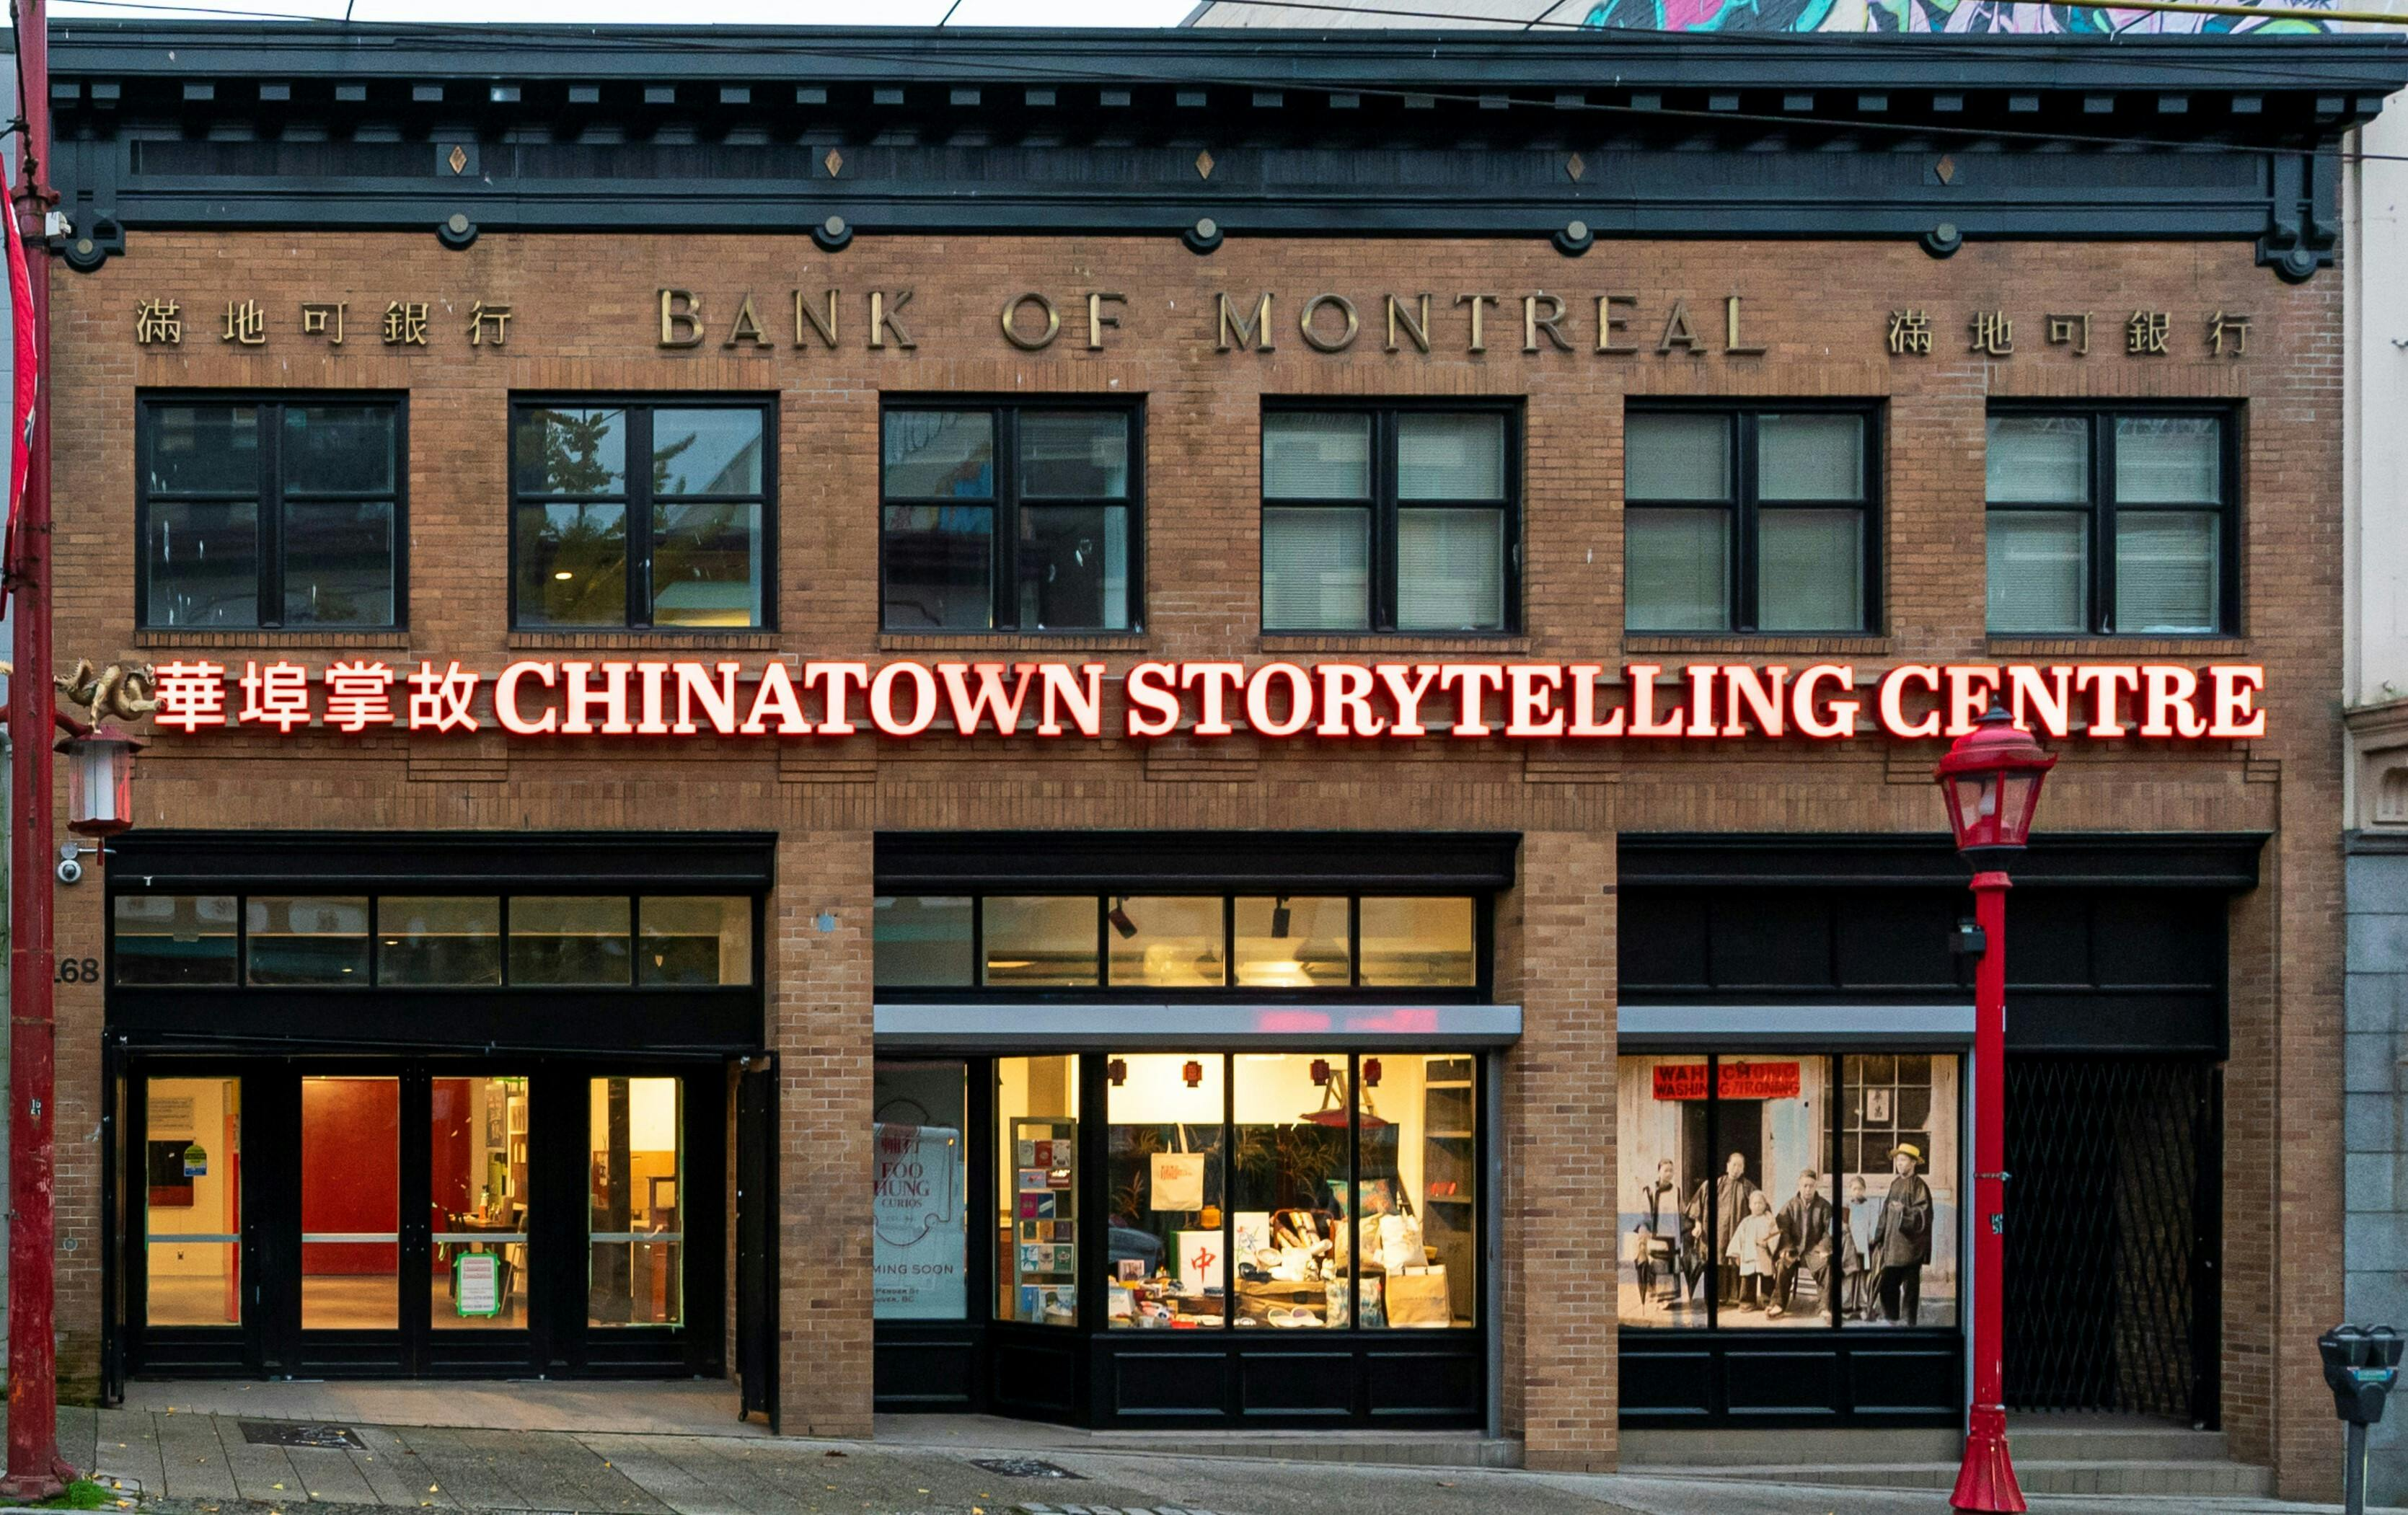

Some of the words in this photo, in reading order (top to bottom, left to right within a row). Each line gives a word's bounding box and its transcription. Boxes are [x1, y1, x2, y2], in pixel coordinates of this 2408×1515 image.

[136, 299, 512, 345] 滿地可銀行
[658, 288, 917, 348] BANK
[1002, 293, 1127, 350] OF
[1216, 292, 1767, 354] MONTREAL
[1888, 309, 2252, 355] 滿地可銀行
[154, 660, 480, 733] 華埠掌故
[493, 660, 1106, 736] CHINATOWN
[1127, 662, 1860, 737] STORYTELLING
[1880, 665, 2266, 737] CENTRE
[54, 958, 100, 983] 68
[1658, 1066, 1706, 1081] WAH
[881, 1162, 923, 1178] FOO
[881, 1198, 922, 1208] CURIOS
[912, 1264, 953, 1275] SOON
[1191, 1253, 1217, 1284] 中
